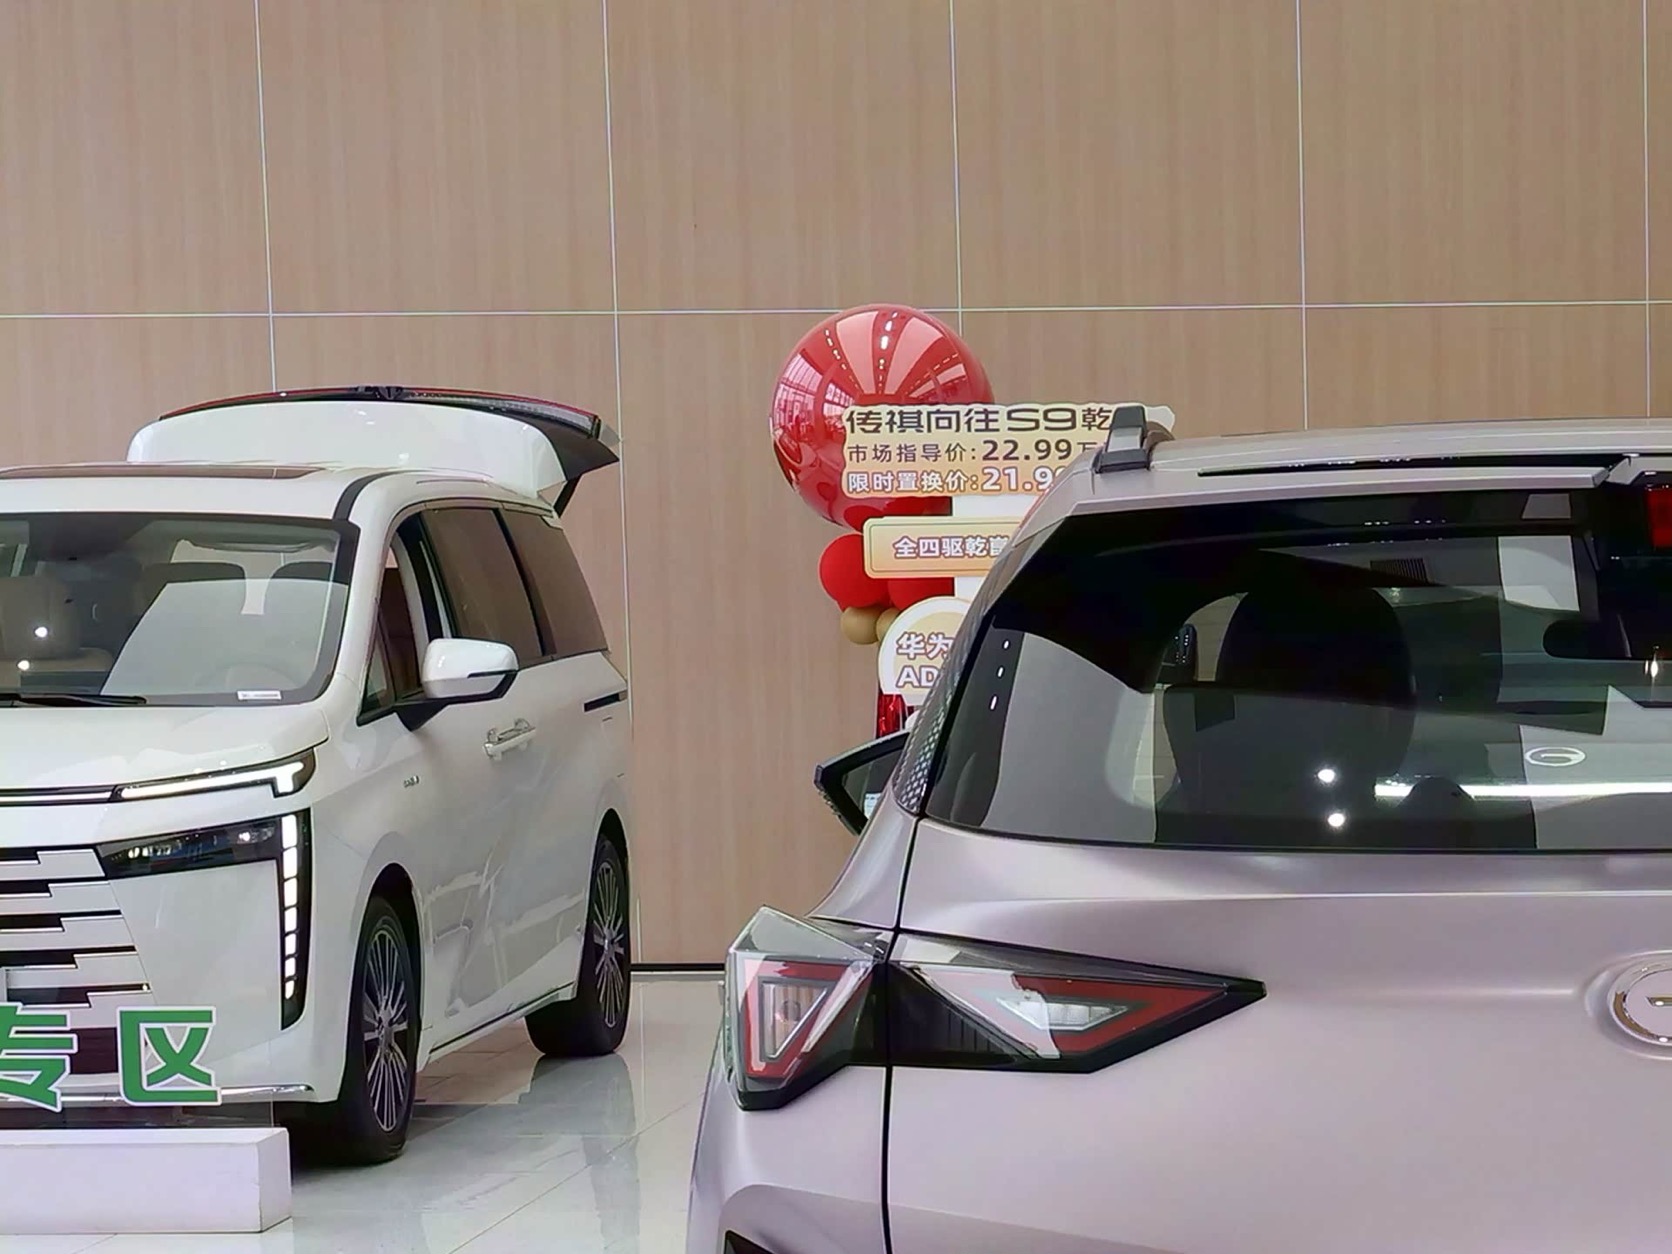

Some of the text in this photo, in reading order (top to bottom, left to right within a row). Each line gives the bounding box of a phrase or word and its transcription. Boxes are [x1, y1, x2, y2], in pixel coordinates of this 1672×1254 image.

[848, 467, 1064, 493] 限时置换价:21.9
